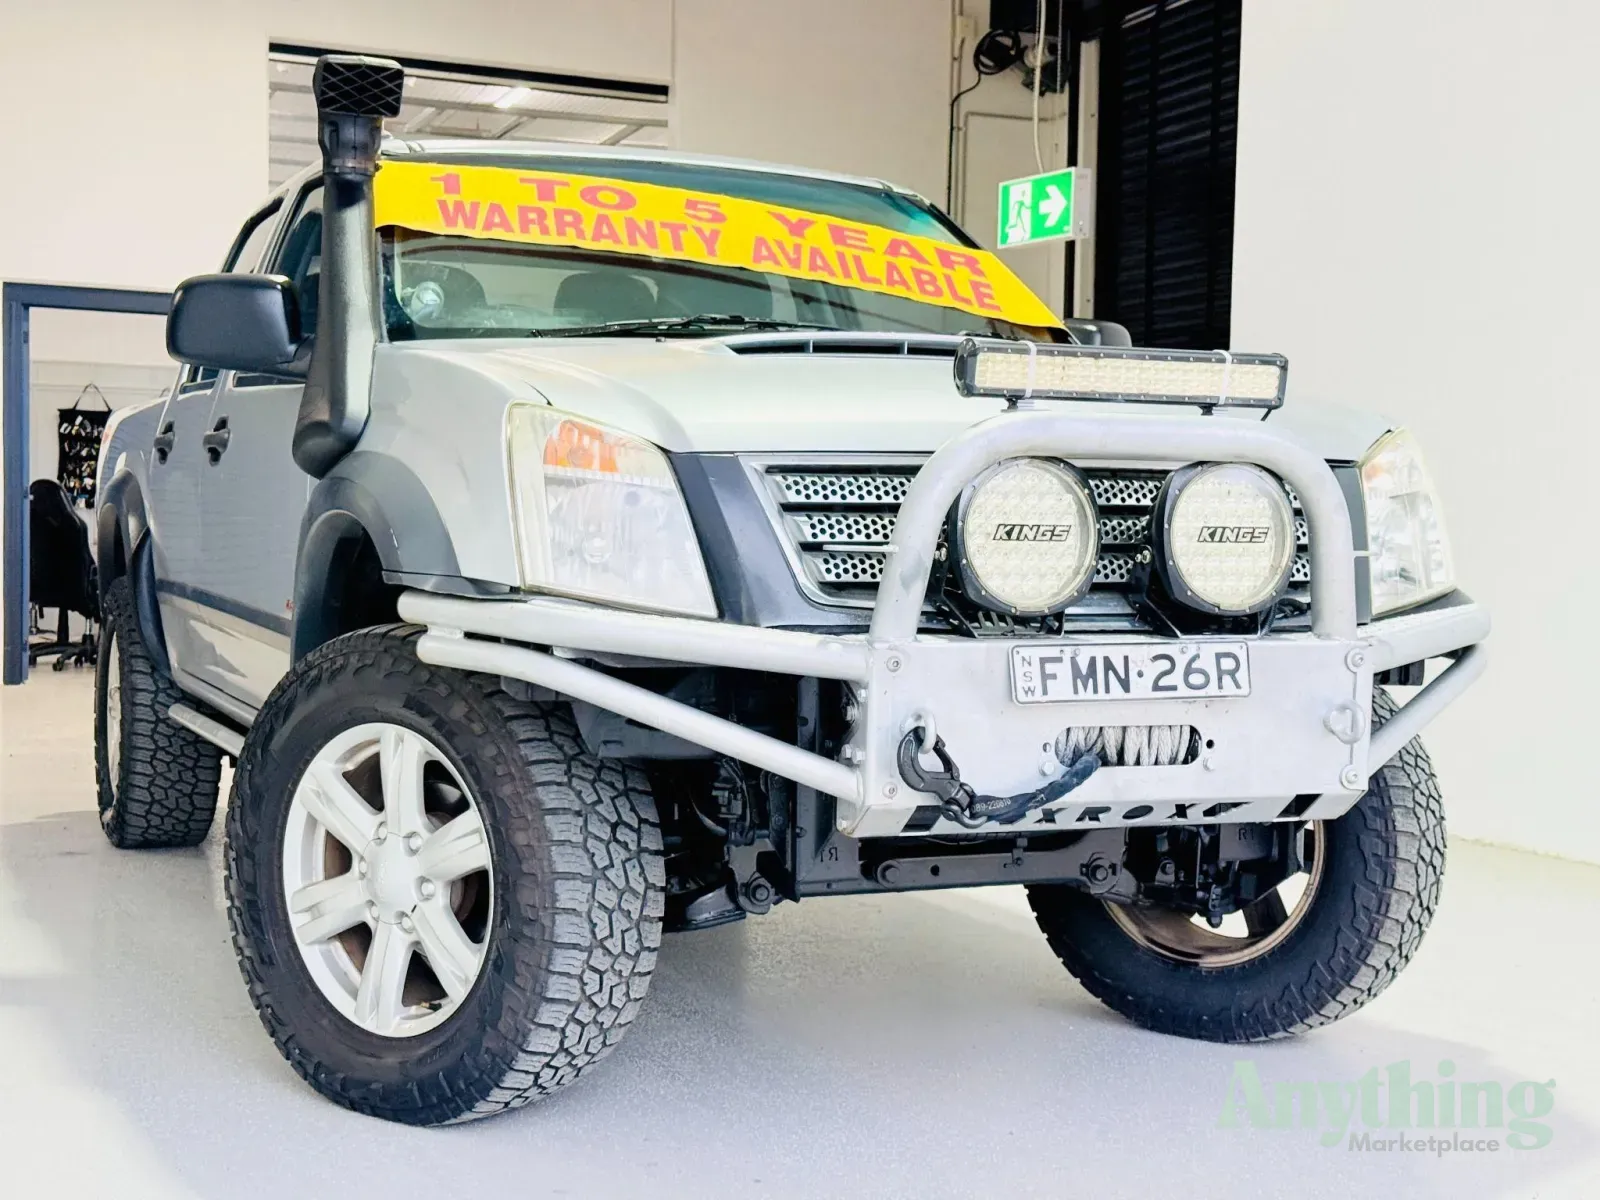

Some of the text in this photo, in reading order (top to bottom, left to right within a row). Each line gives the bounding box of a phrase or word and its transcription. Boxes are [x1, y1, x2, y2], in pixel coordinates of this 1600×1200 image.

[430, 173, 987, 279] 1 TO 5 YEAR
[436, 199, 1002, 313] WARRANTY AVAILABLE
[992, 523, 1072, 542] KINGS
[1197, 526, 1270, 543] KINGS
